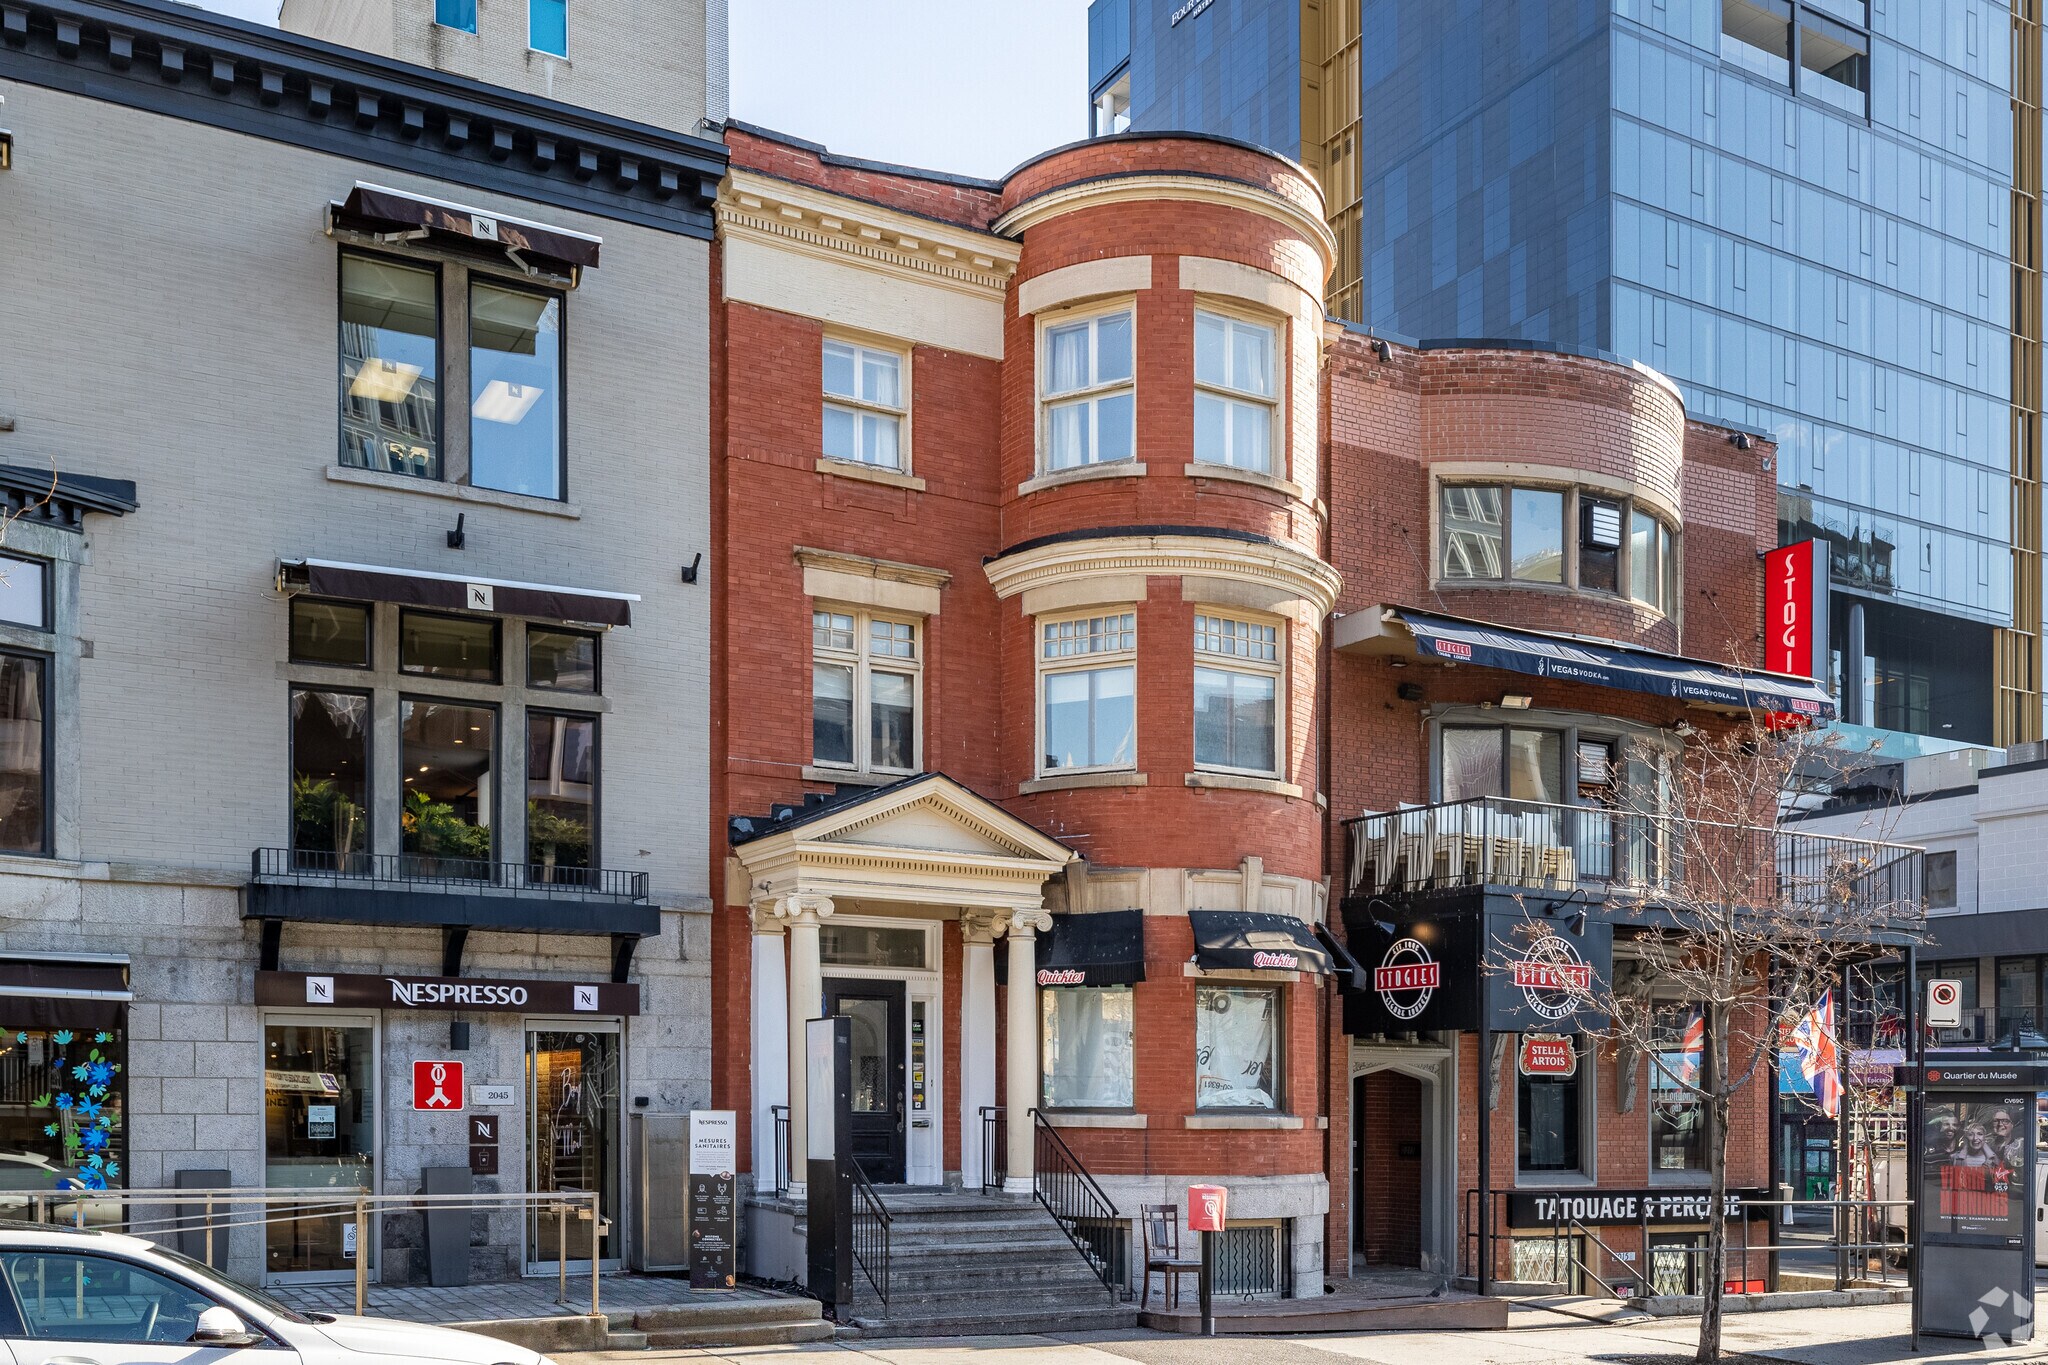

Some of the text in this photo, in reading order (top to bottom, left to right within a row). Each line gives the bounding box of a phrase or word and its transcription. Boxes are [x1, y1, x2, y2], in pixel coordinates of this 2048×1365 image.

[1782, 553, 1796, 673] STOGI
[1252, 952, 1298, 968] Quickies
[1037, 969, 1085, 985] Quickies
[1380, 967, 1435, 988] STOGIES
[385, 978, 528, 1006] NESPRESSO
[1531, 1045, 1564, 1055] STELLA
[1531, 1056, 1566, 1066] ARTOIS
[1944, 1071, 2018, 1081] Quartier du Musée
[487, 1091, 509, 1100] 2045
[1535, 1197, 1638, 1220] TATOUAGE
